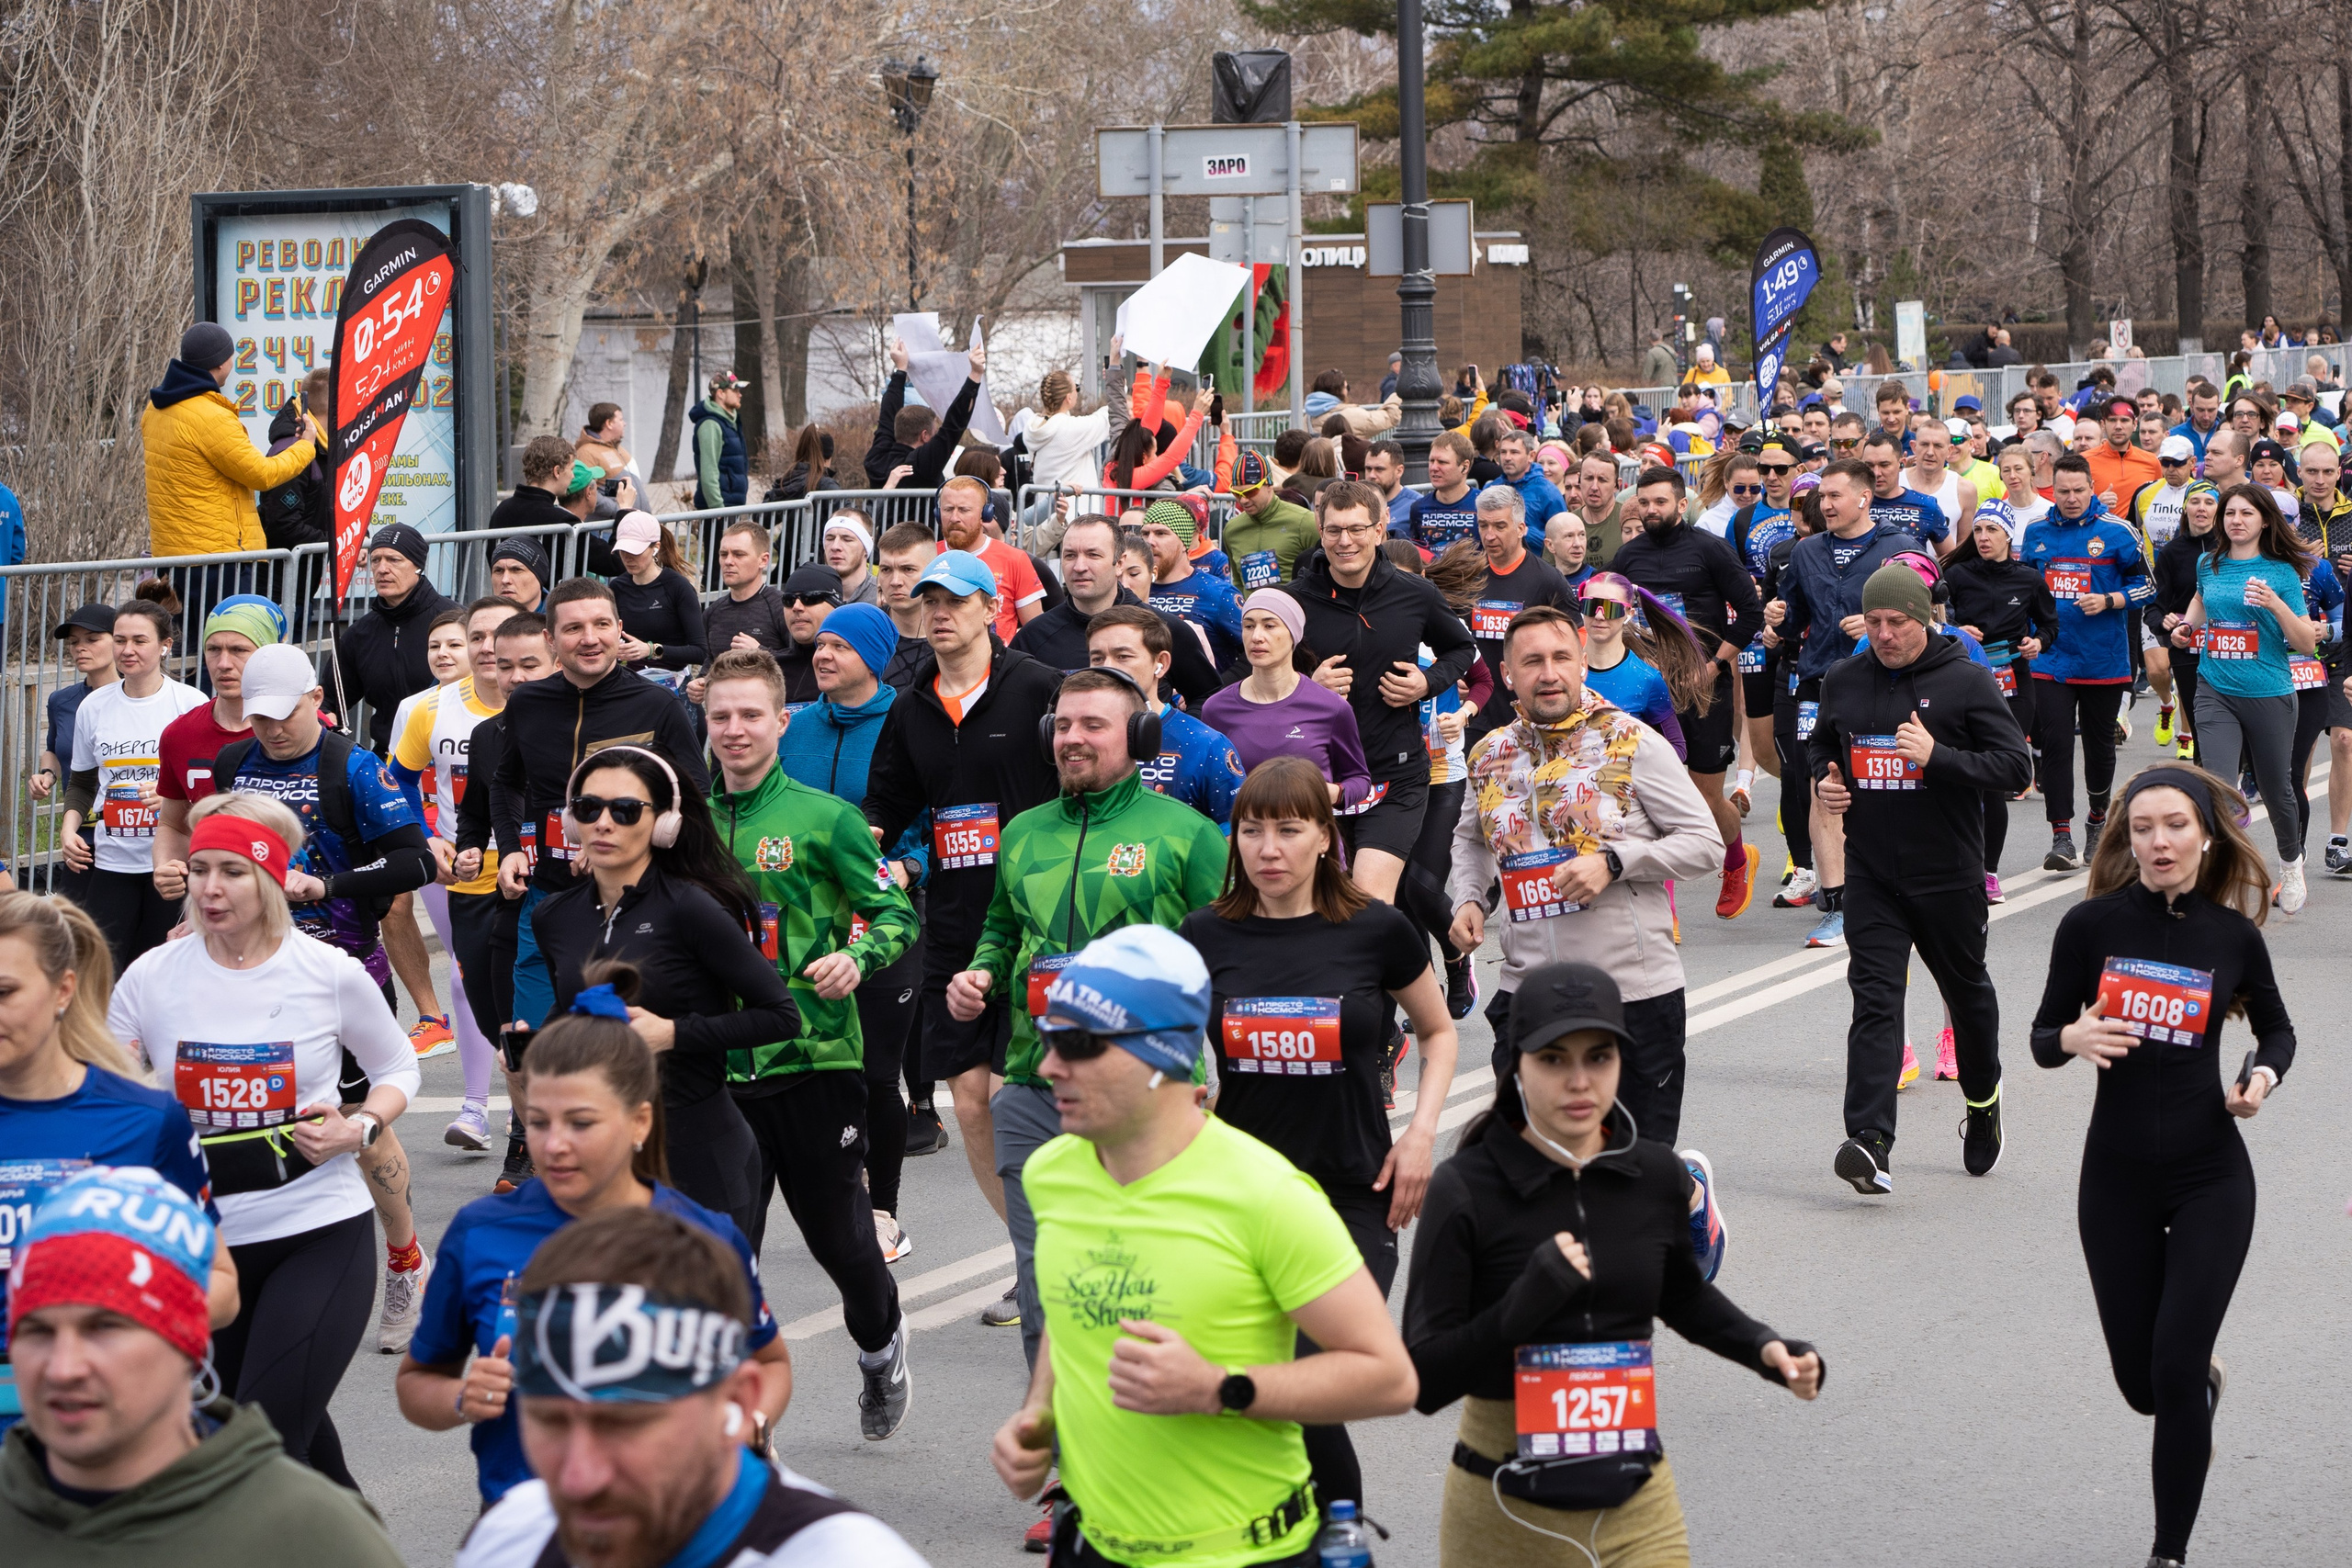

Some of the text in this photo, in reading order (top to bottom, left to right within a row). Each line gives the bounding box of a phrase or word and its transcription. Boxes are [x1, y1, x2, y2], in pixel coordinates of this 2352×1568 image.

[1763, 241, 1794, 268] GARMIN
[364, 246, 416, 295] GARMIN
[1762, 259, 1799, 304] 1:49
[354, 277, 424, 364] 0:54
[1247, 564, 1271, 581] 2220
[2053, 577, 2079, 591] 1462
[1482, 615, 1510, 631] 1636
[2216, 636, 2246, 650] 1626
[1866, 758, 1904, 777] 1319
[118, 808, 155, 826] 1674
[944, 829, 981, 854] 1355
[2135, 969, 2179, 981] КОСМОС
[2144, 964, 2180, 975] ПРОСТО
[2121, 989, 2185, 1026] 1608
[2188, 1004, 2198, 1013] D
[1232, 1029, 1316, 1059] E 1580
[199, 1077, 281, 1108] 1528 D
[69, 1187, 208, 1258] RUN
[1066, 1269, 1155, 1302] See You
[1561, 1355, 1617, 1364] КОСМОС
[1552, 1385, 1628, 1429] 1257
